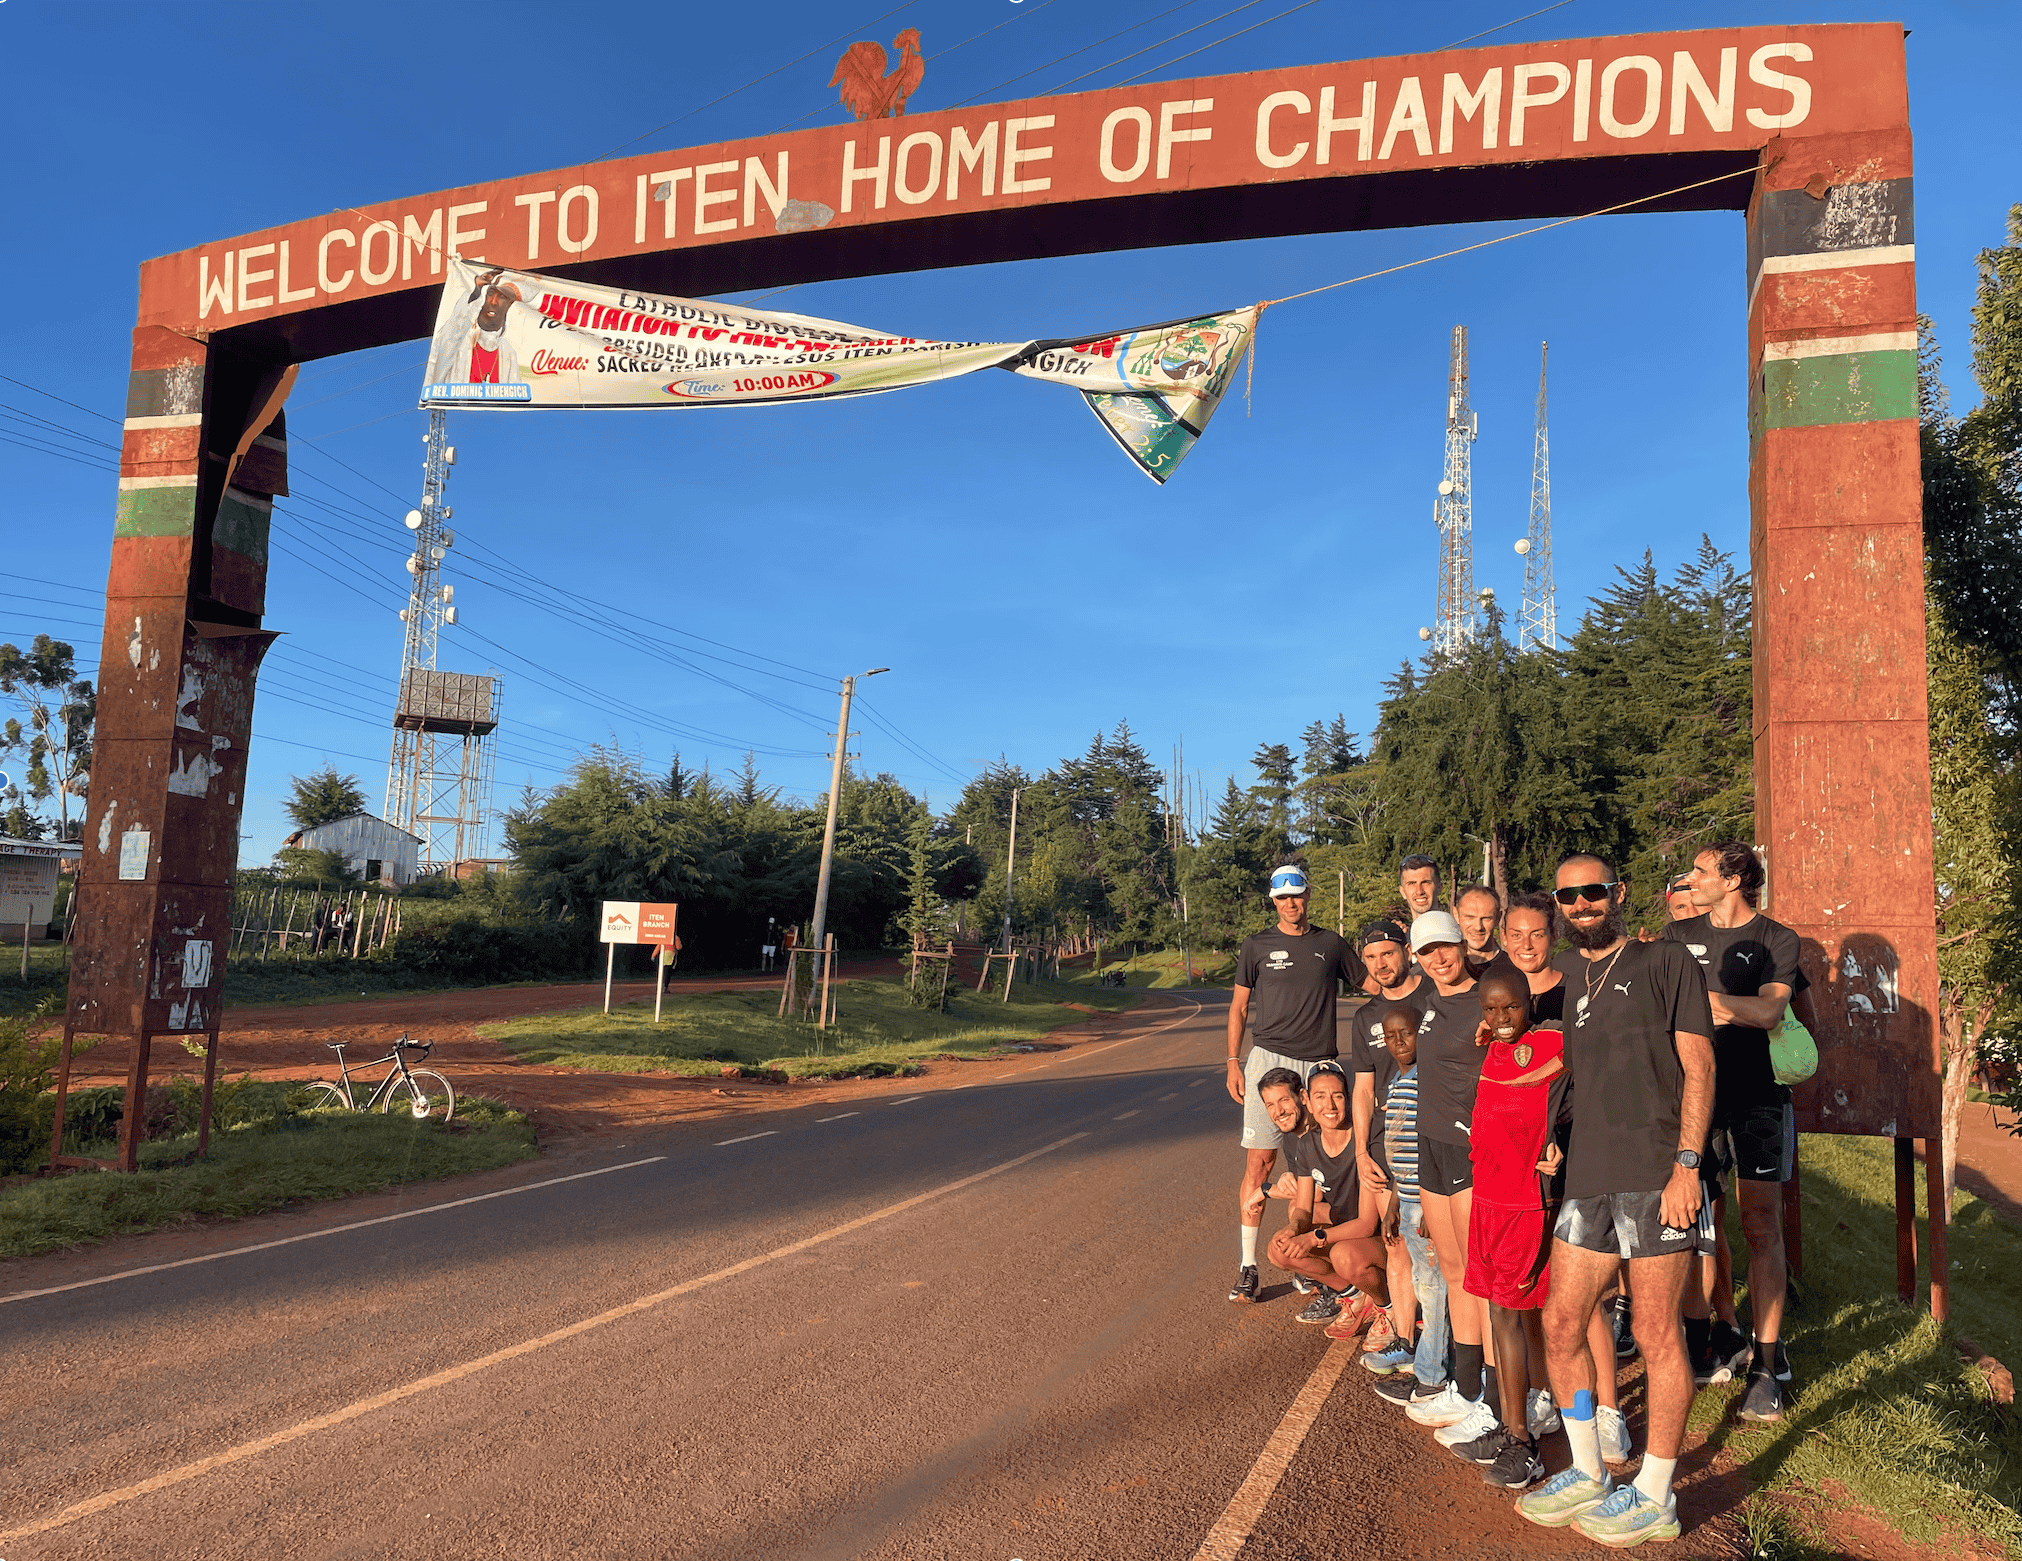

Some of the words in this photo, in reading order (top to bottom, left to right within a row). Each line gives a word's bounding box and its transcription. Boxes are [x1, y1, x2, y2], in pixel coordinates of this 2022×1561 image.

[199, 200, 488, 320] WELCOME
[514, 184, 600, 260] TO
[634, 150, 790, 244] ITEN
[840, 115, 1056, 214] HOME
[1100, 98, 1214, 183] OF
[1255, 42, 1815, 169] CHAMPIONS
[843, 347, 893, 360] ITEN
[531, 348, 590, 376] Venue:
[683, 379, 726, 396] Time:
[732, 375, 785, 392] 10:00
[787, 373, 816, 388] AM
[431, 385, 449, 398] REV.
[450, 385, 484, 398] DOMINIC
[23, 846, 62, 857] THERAPY
[1660, 1231, 1687, 1241] adidas
